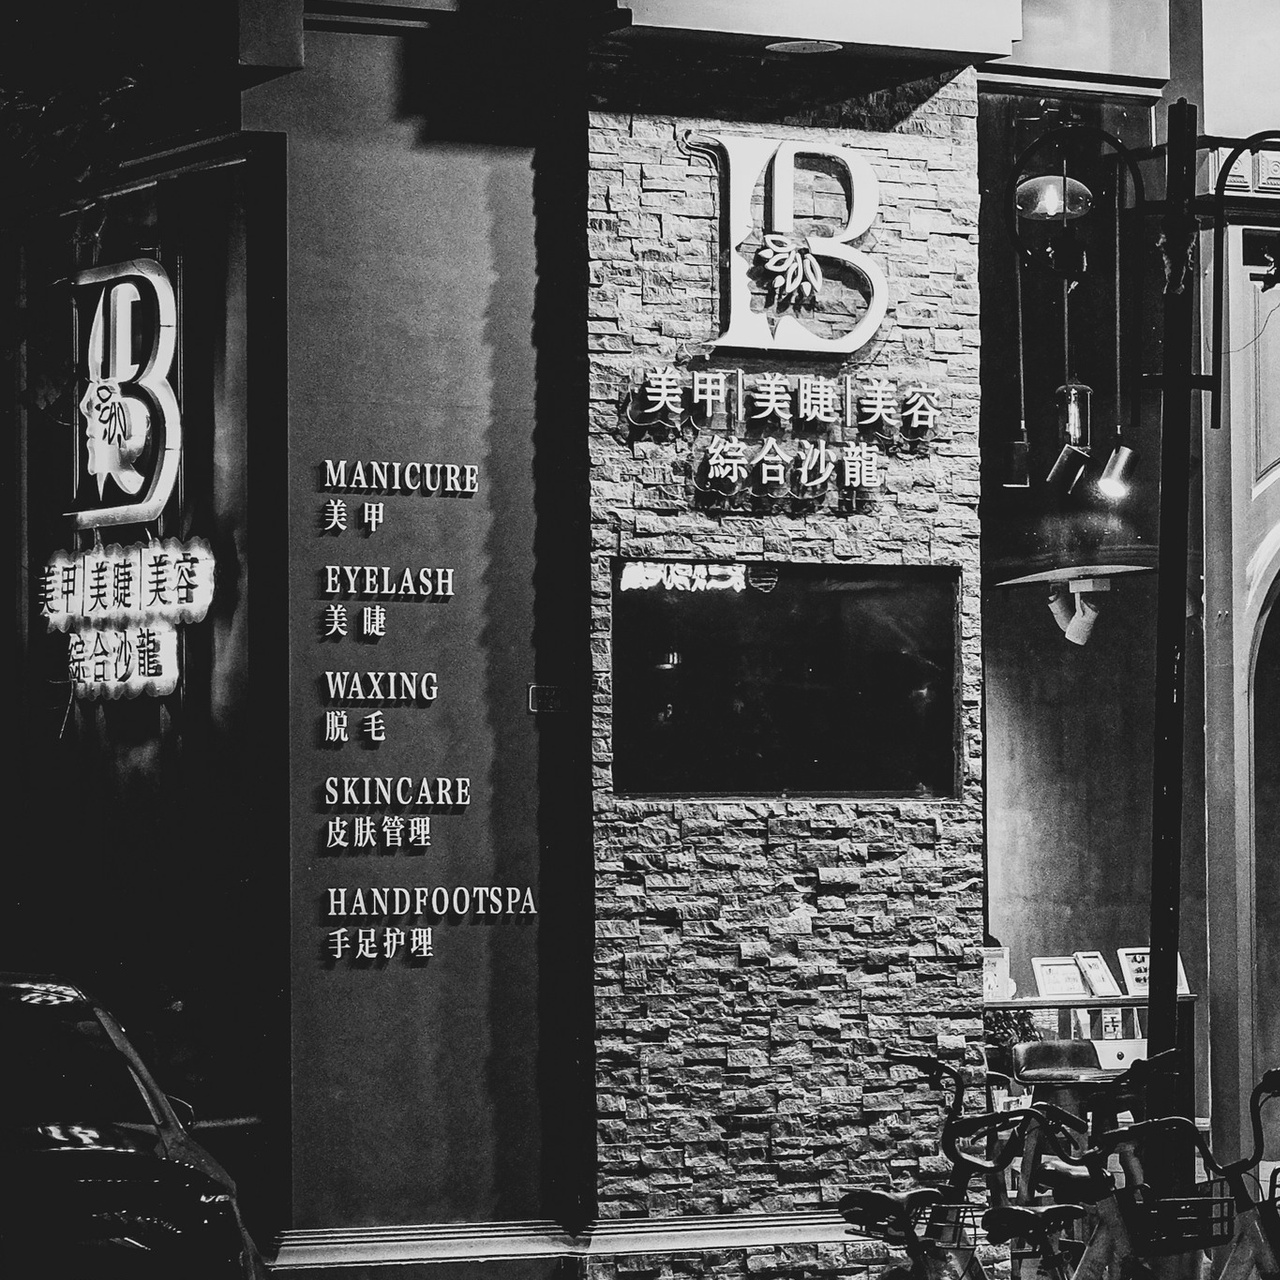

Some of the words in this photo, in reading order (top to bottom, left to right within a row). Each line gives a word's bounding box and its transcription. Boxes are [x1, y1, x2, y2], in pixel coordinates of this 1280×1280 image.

[324, 459, 479, 493] MANICURE
[707, 435, 885, 488] 綜合沙龍
[324, 499, 384, 532] 美甲
[325, 565, 455, 596] EYELASH
[325, 604, 386, 637] 美睫
[325, 671, 439, 701] WAXING
[325, 710, 387, 742] 脱毛
[325, 776, 472, 806] SKINCARE
[326, 816, 432, 848] 皮肤管理
[328, 886, 538, 916] HANDFOOTSPA
[328, 927, 434, 960] 手足护理
